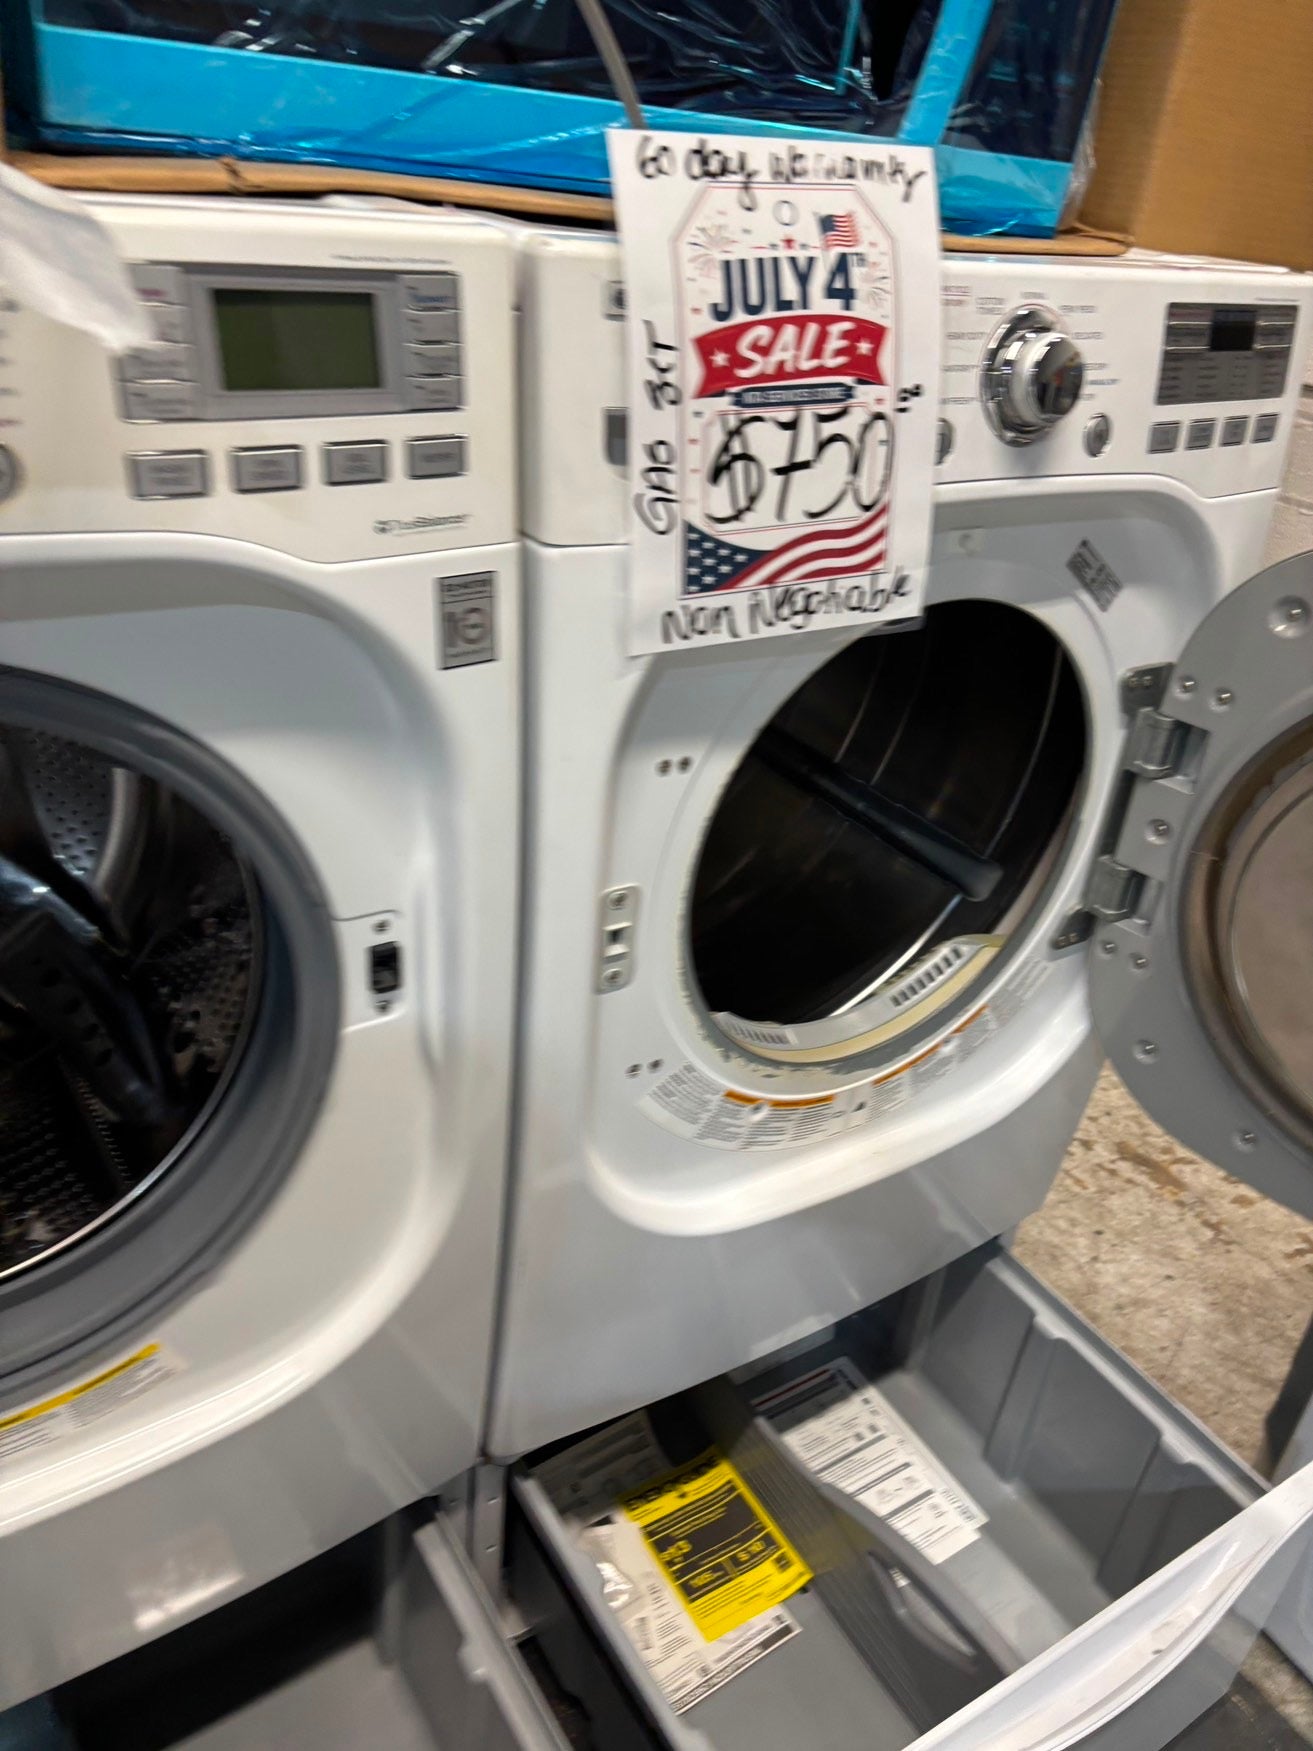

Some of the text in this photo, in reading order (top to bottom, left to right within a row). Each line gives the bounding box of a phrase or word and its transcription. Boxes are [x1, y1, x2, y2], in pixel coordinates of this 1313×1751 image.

[685, 138, 757, 211] day
[708, 256, 818, 322] JULY
[821, 252, 858, 311] 4
[733, 320, 857, 378] SALE
